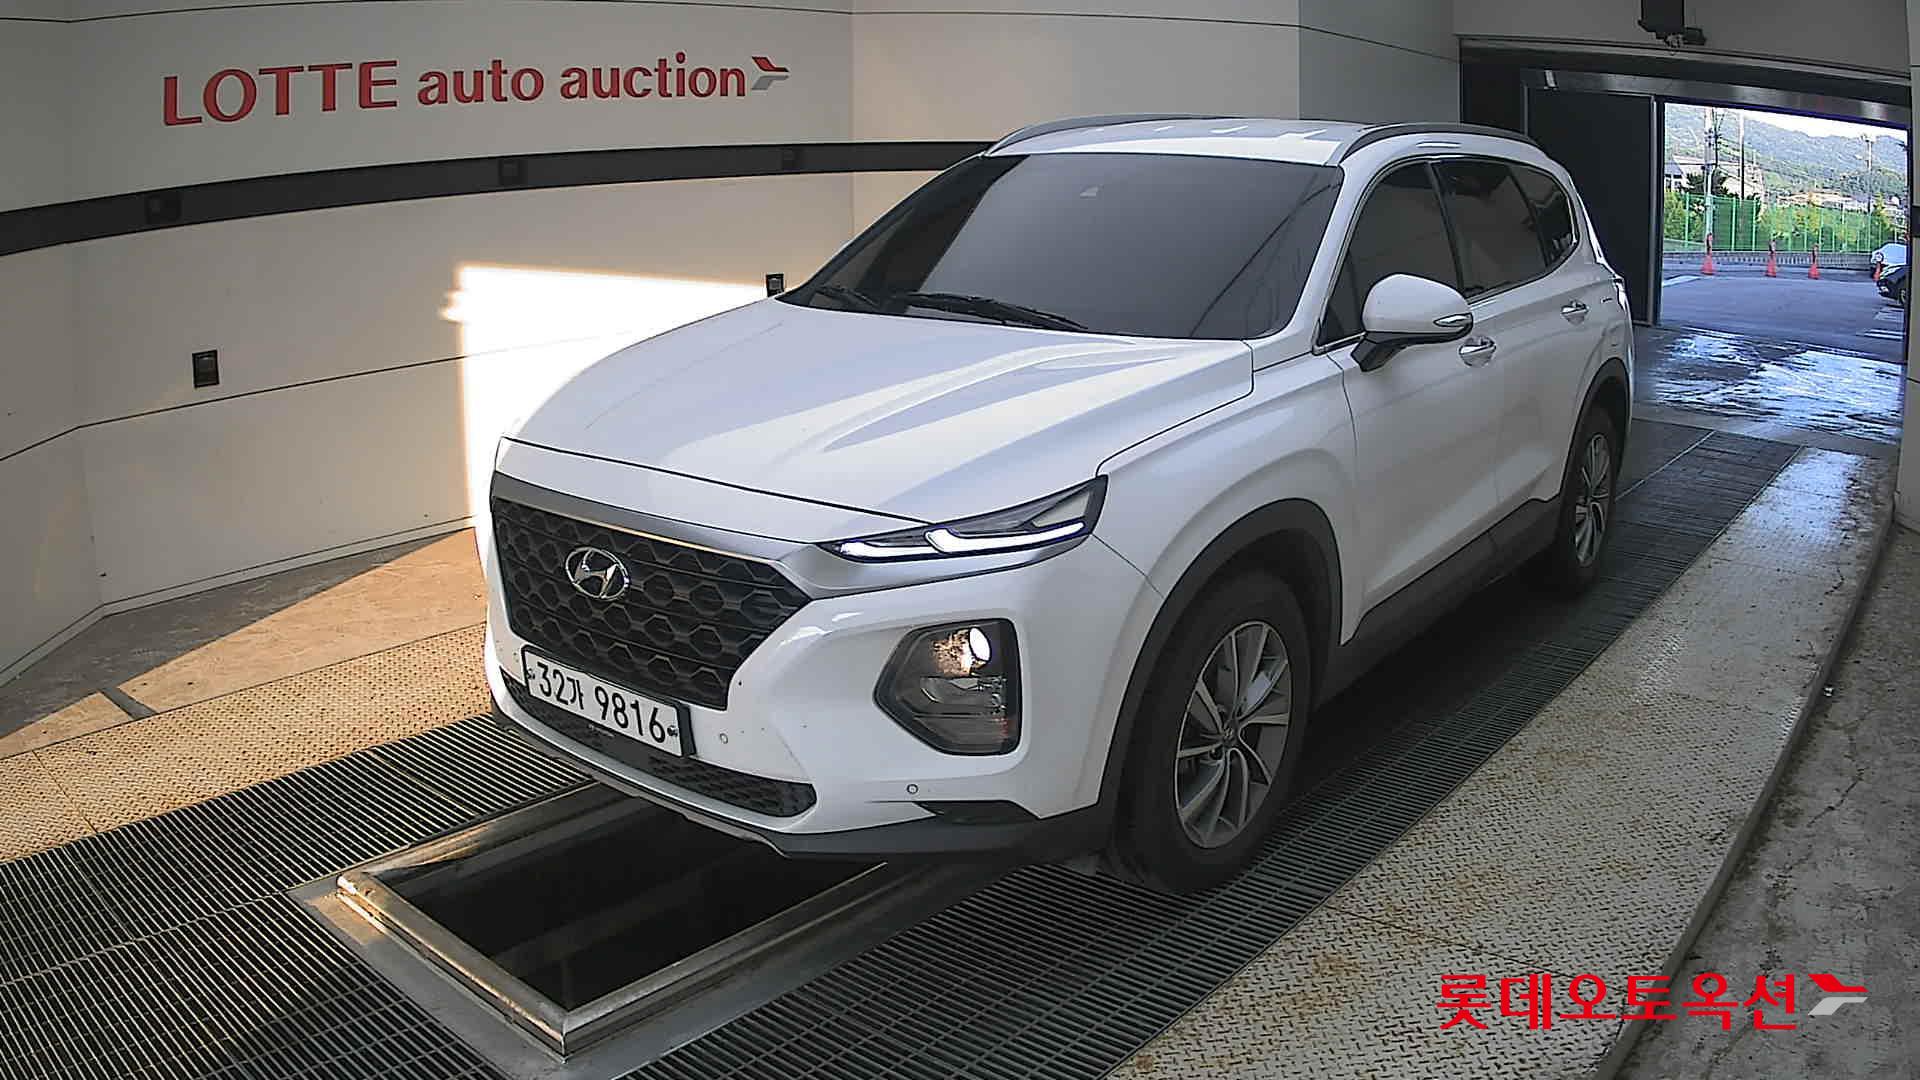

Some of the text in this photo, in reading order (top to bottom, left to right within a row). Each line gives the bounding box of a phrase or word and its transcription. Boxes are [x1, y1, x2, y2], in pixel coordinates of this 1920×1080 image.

[162, 51, 746, 127] LOTTE auto auction
[537, 661, 666, 744] 32가 9816
